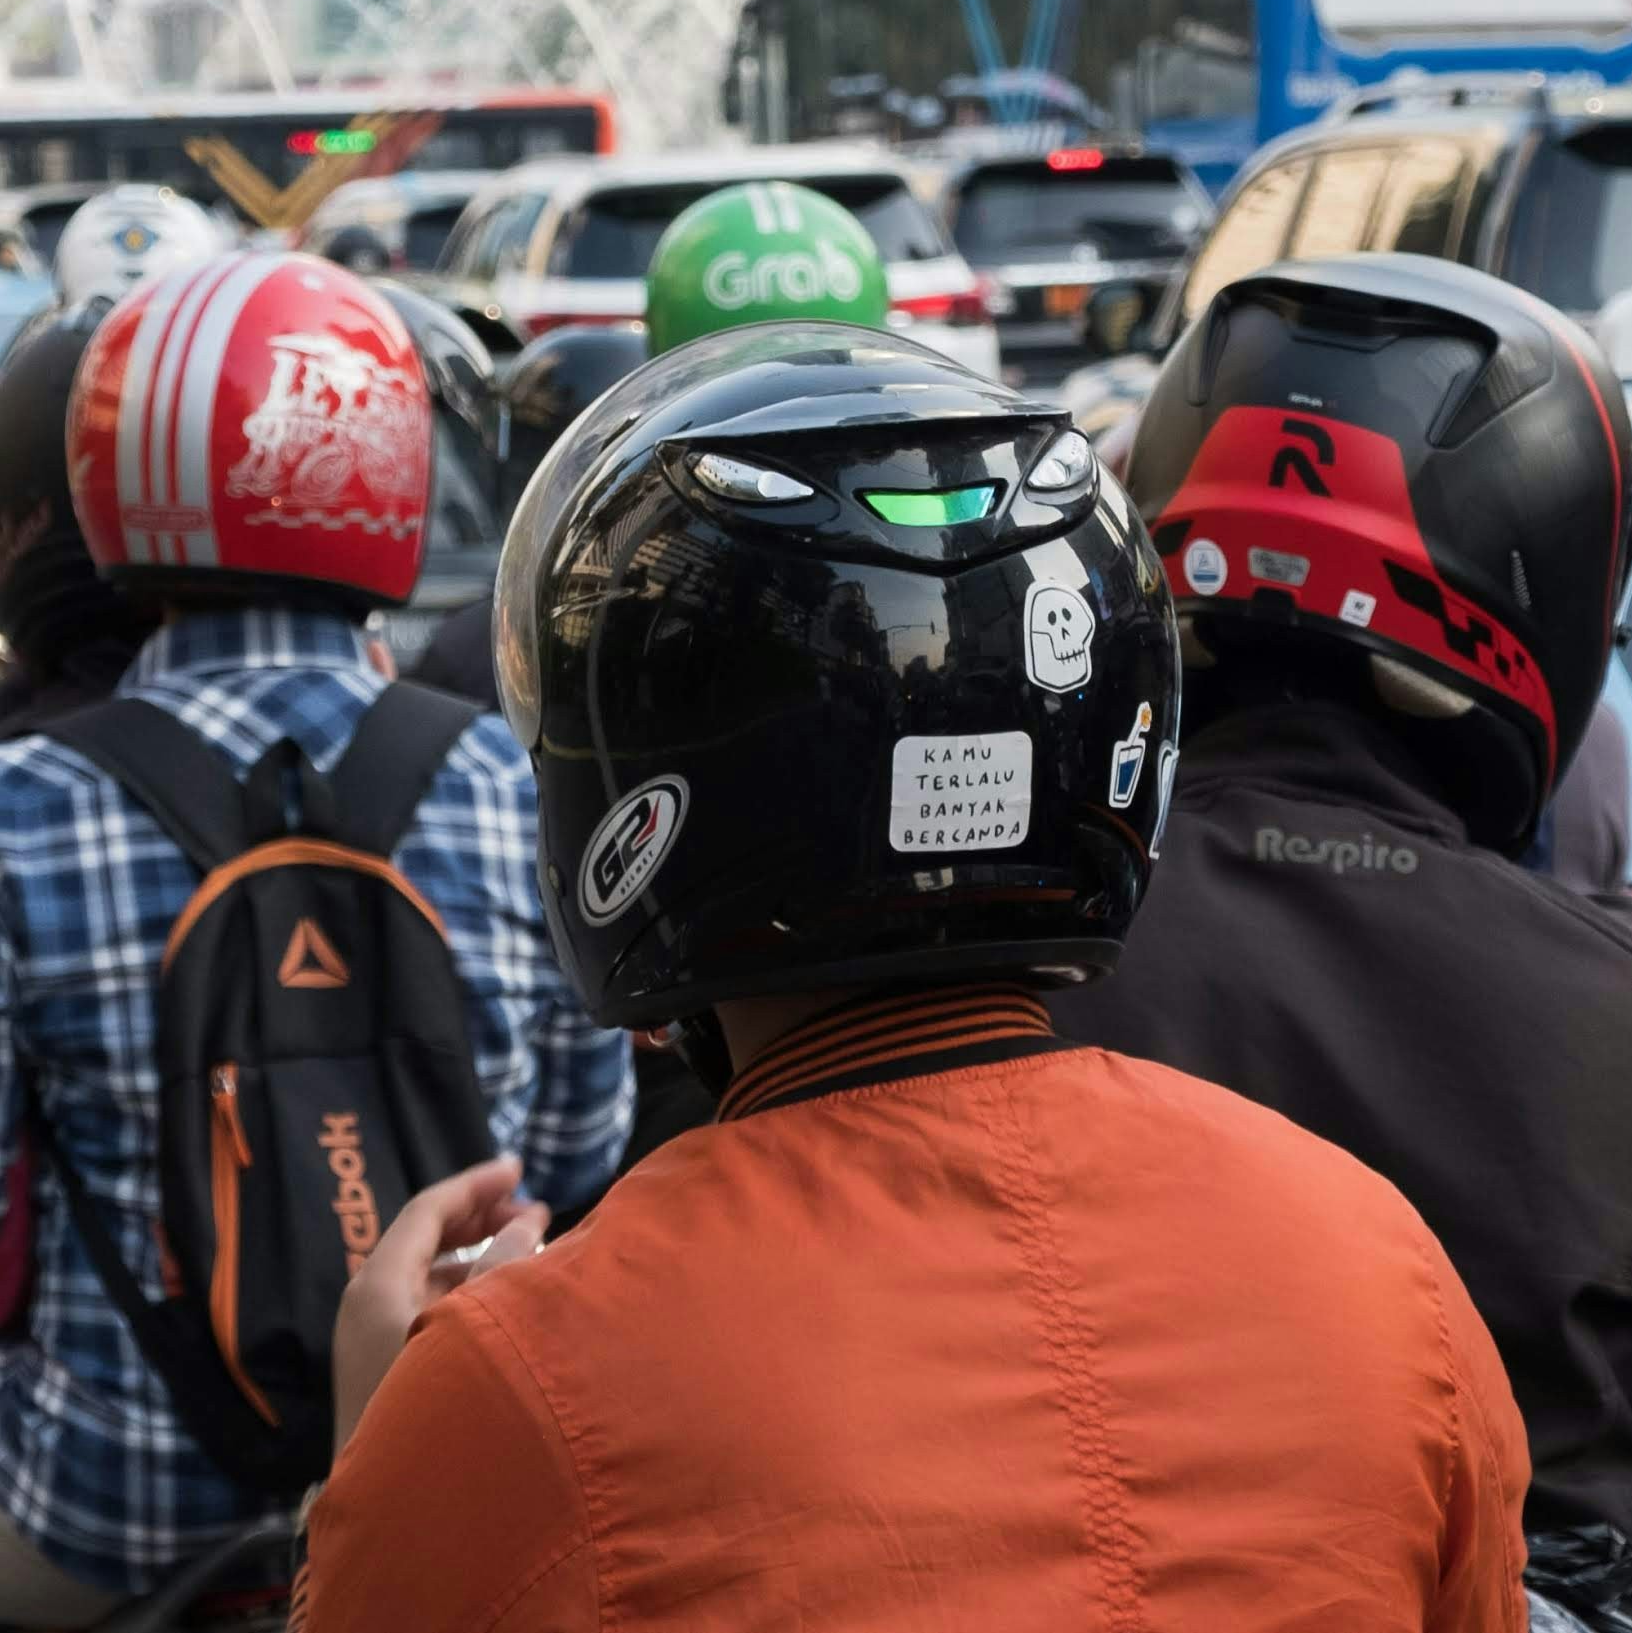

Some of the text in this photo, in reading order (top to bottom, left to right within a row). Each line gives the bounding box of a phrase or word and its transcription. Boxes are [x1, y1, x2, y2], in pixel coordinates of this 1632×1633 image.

[703, 239, 862, 310] Grab
[924, 747, 992, 764] KAMU
[916, 770, 1015, 791] TERLALU
[920, 798, 1006, 819] BANYAK
[904, 821, 1021, 845] BERCANDA
[1255, 827, 1419, 874] Respiro
[318, 1111, 381, 1282] ebok
